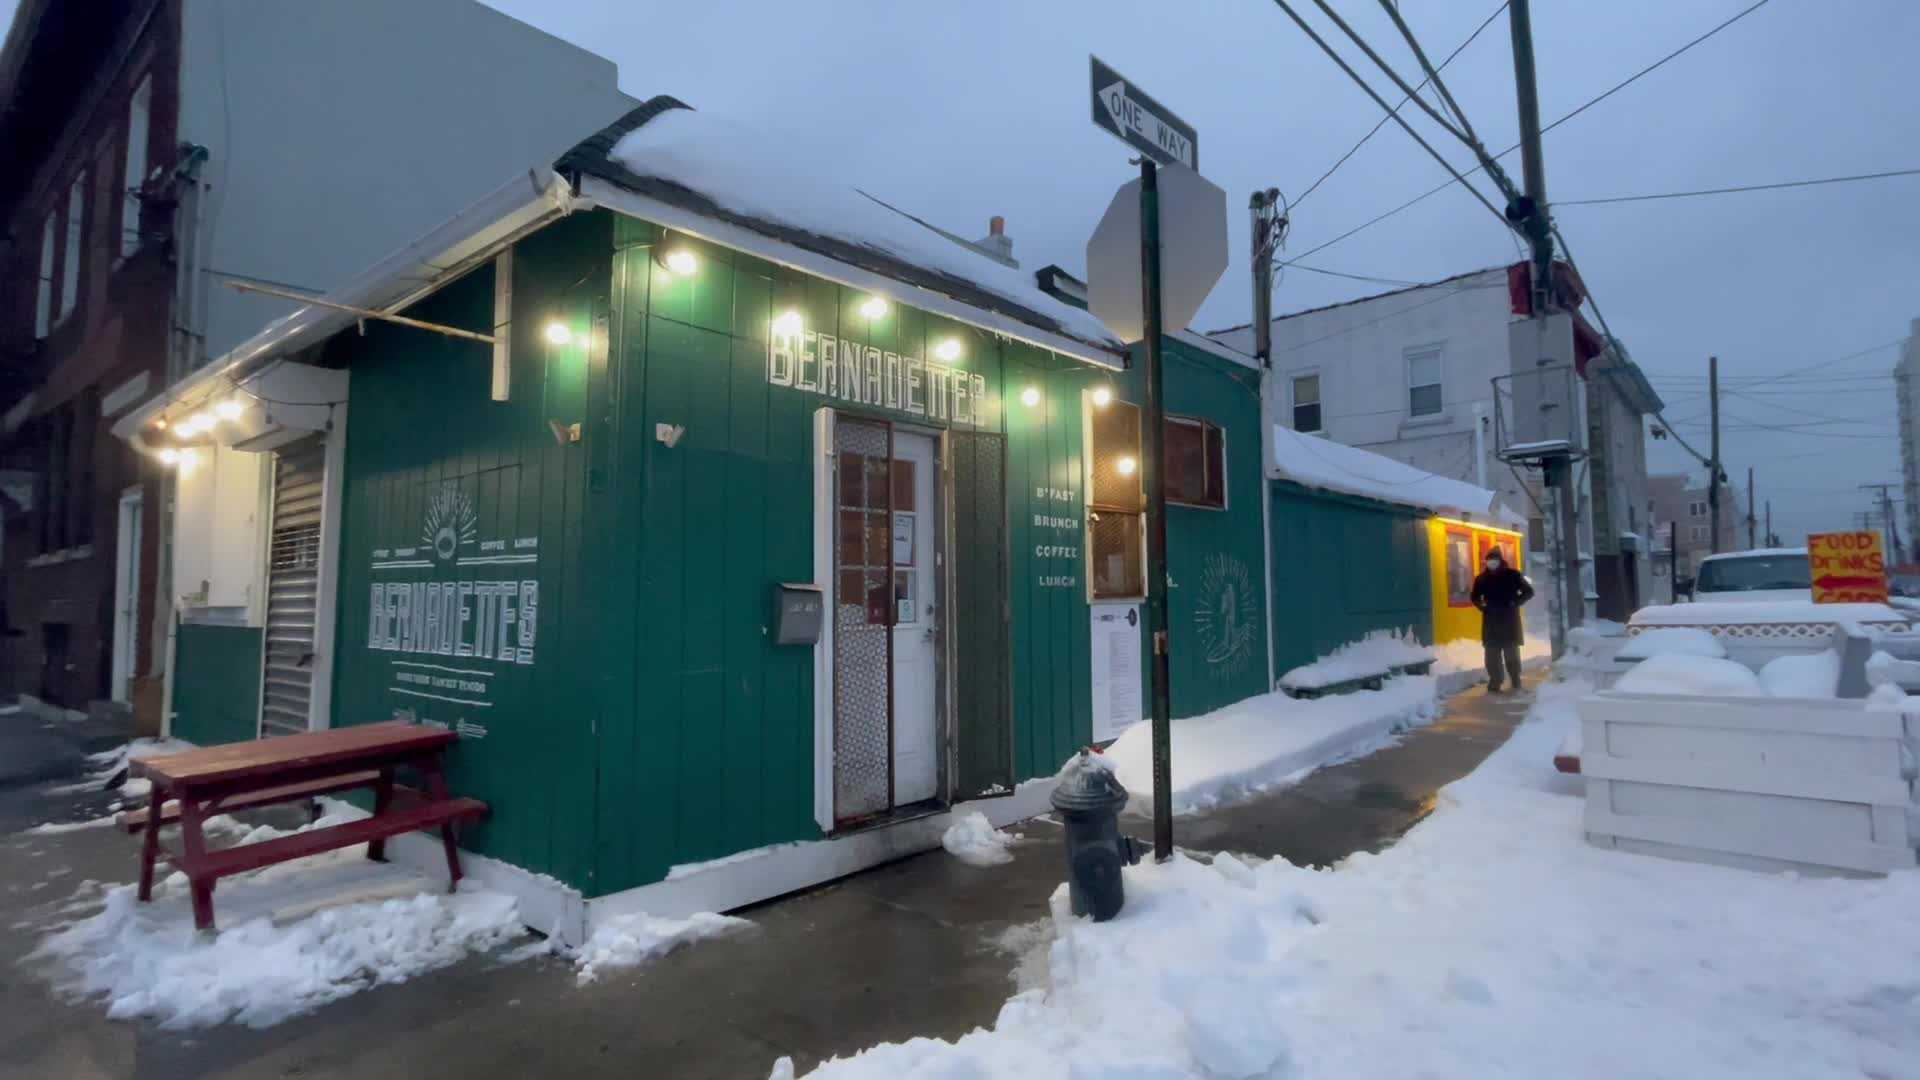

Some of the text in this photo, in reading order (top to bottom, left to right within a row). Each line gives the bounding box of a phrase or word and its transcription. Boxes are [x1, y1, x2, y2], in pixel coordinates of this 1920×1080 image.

[1111, 92, 1186, 160] ONE WAY
[1034, 514, 1079, 529] BRUNCH
[1809, 533, 1873, 550] FOOD
[1035, 545, 1078, 559] COFFEE
[1039, 575, 1076, 587] LUNCH
[368, 580, 538, 664] BERNADETTES
